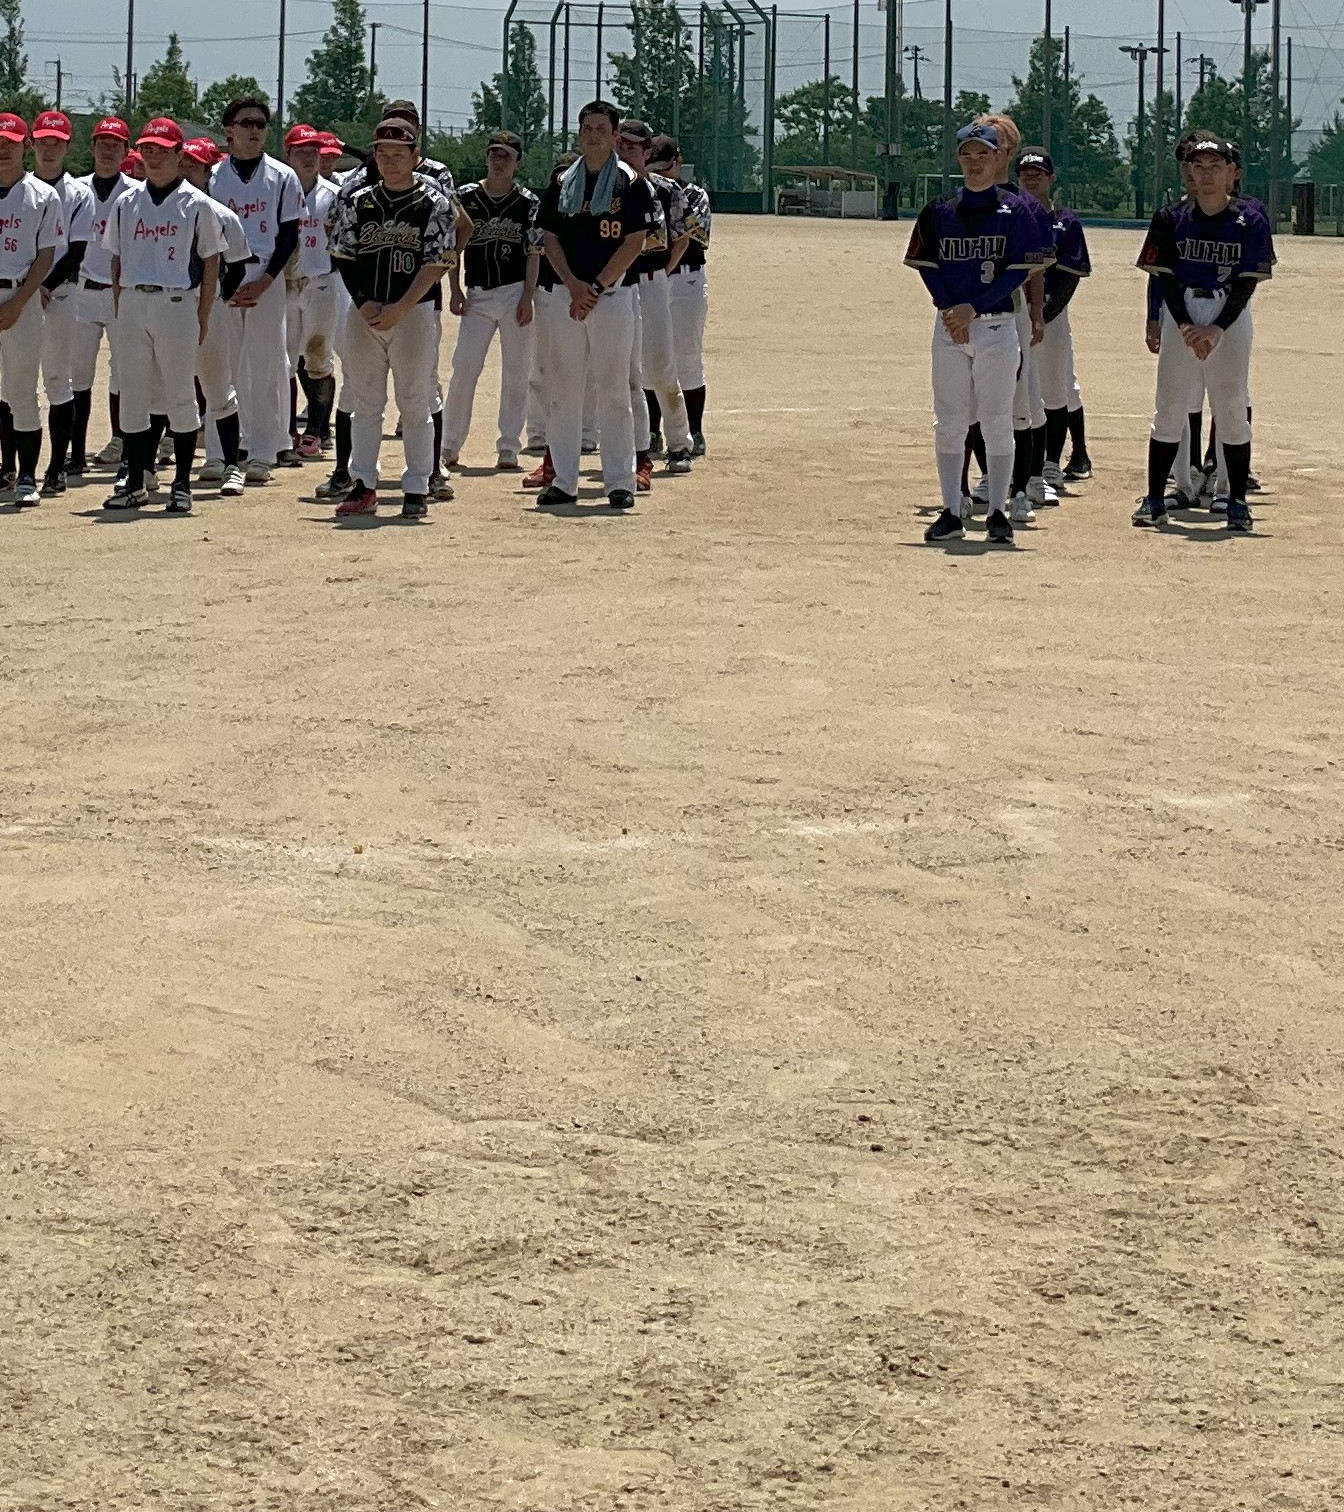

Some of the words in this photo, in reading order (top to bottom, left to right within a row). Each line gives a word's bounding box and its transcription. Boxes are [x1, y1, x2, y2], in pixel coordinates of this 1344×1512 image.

[133, 218, 179, 243] Angels
[259, 220, 268, 234] 6
[599, 219, 622, 239] 98
[167, 246, 175, 261] 2
[938, 235, 1007, 262] NUHW
[392, 249, 416, 275] 10
[980, 260, 996, 284] 3
[1216, 266, 1233, 283] 7
